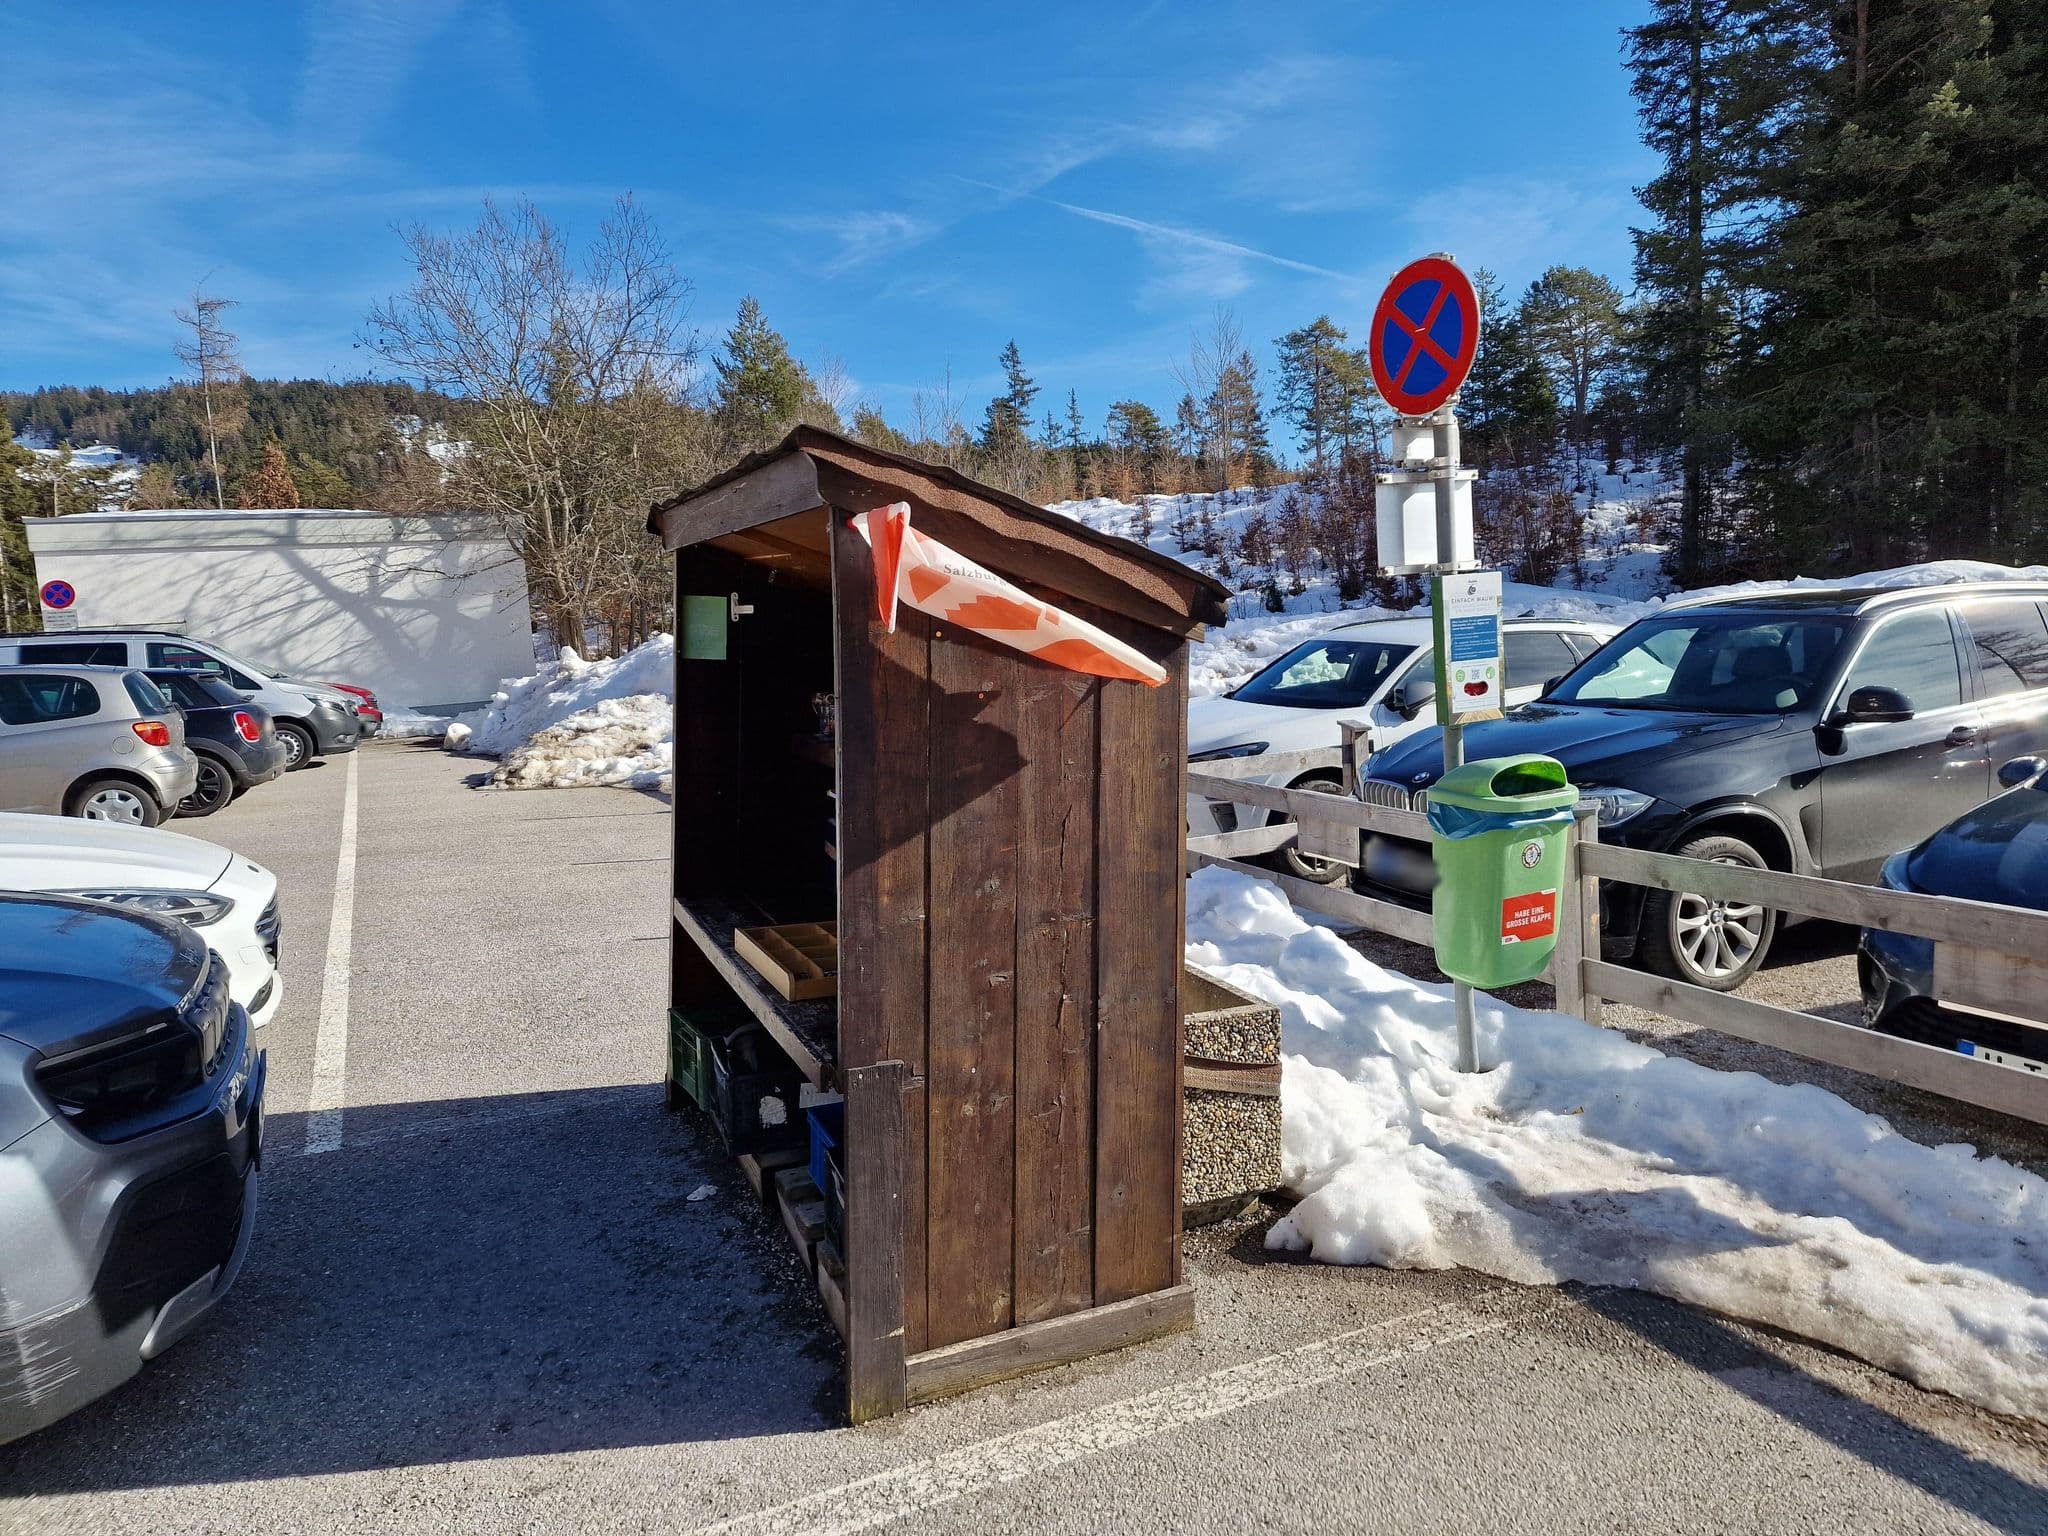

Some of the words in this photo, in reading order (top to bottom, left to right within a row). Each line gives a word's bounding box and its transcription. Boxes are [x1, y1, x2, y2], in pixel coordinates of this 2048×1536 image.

[1514, 909, 1530, 919] HABE
[1531, 905, 1545, 916] EINE
[1506, 917, 1530, 929] GROSSE
[1530, 912, 1552, 924] KLAPPE
